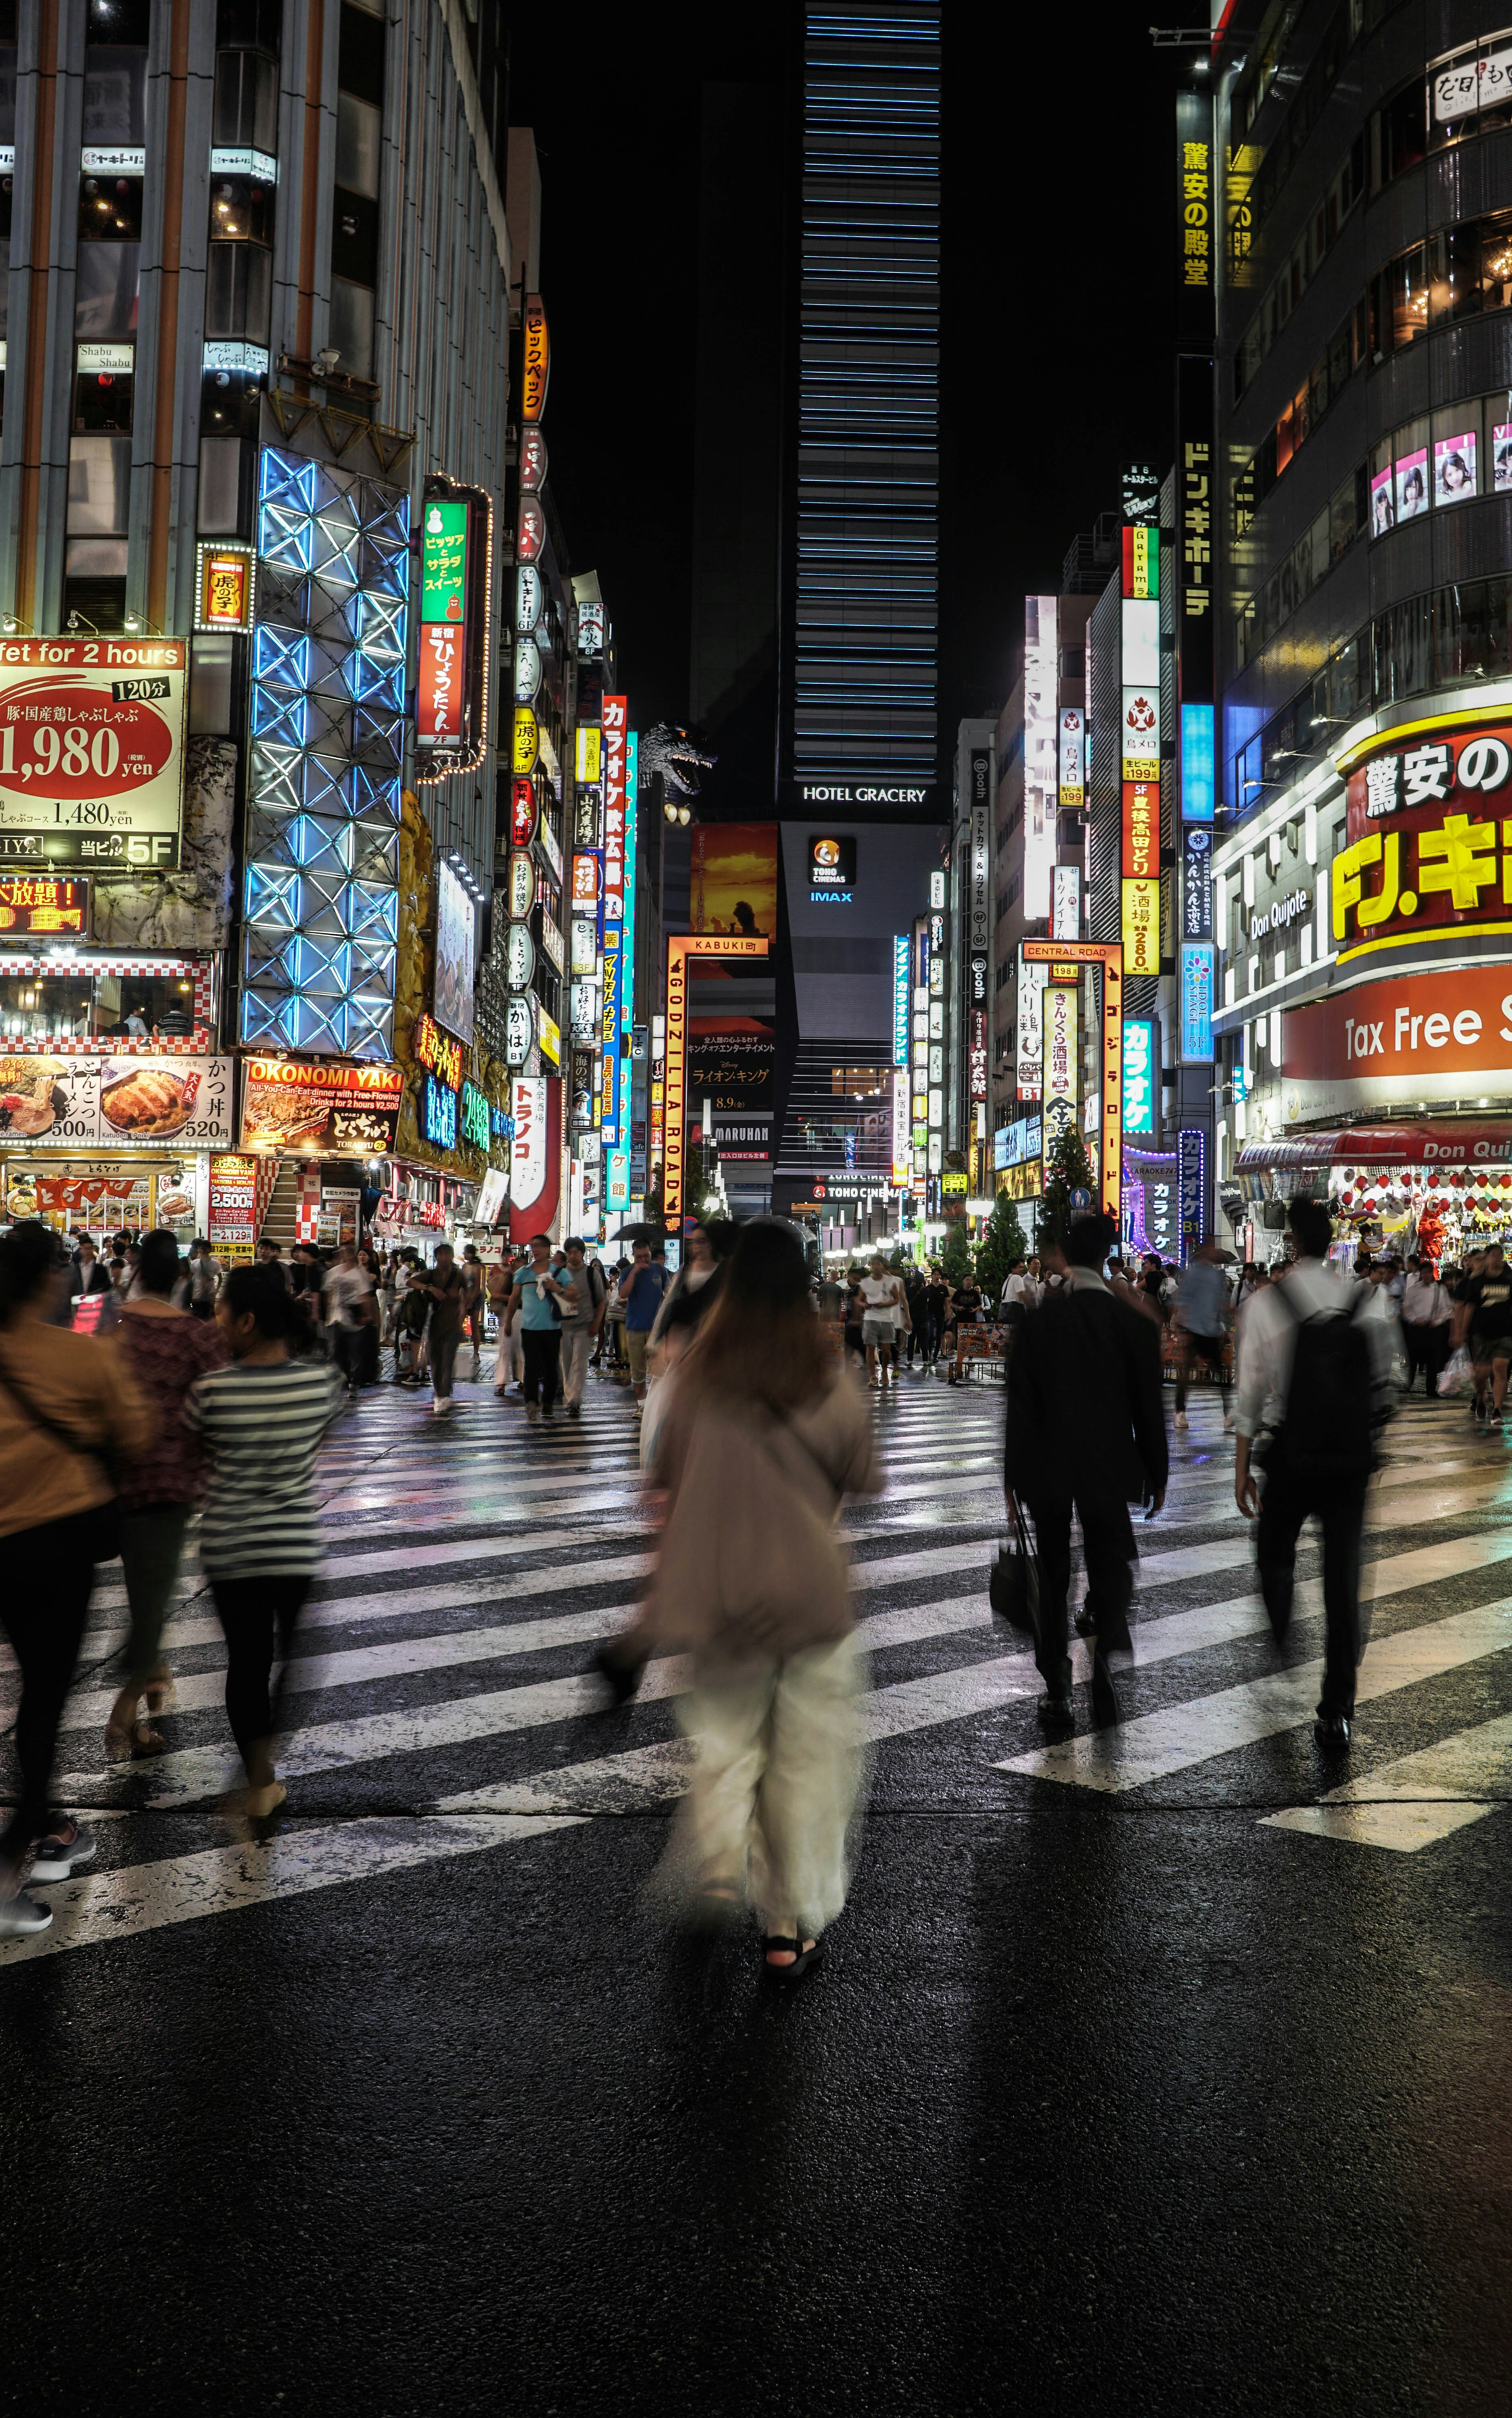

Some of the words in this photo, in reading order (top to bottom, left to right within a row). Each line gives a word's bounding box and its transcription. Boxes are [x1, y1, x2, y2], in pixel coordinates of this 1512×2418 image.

[1183, 142, 1209, 286] 驚安の殿堂
[81, 347, 111, 355] Shabu
[100, 358, 130, 367] Shabu
[427, 555, 461, 571] サラダ
[440, 548, 448, 557] と
[1135, 531, 1147, 583] Garam
[215, 575, 234, 609] 虎の子
[425, 576, 463, 592] スイーツ
[431, 627, 455, 639] 新宿
[519, 620, 534, 629] 6F
[39, 643, 74, 662] for
[83, 644, 98, 663] 2
[108, 644, 178, 665] hours
[117, 679, 166, 700] 120分
[429, 639, 454, 732] ひょうたん
[6, 706, 138, 722] 豚・国産鶏しゃぶしゃぶ
[433, 735, 448, 744] 7F
[516, 725, 534, 758] 虎の子
[0, 726, 119, 782] 1,980
[122, 763, 153, 777] yen
[974, 759, 988, 799] Booth
[1366, 737, 1509, 818] 驚安の
[804, 787, 853, 800] HOTEL
[856, 788, 926, 802] GRACERY
[1064, 793, 1081, 801] 199
[1134, 785, 1147, 794] 5F
[53, 803, 109, 826] 1,480
[110, 815, 132, 826] yen
[579, 795, 594, 838] 山内農場
[976, 812, 984, 858] ネットカフェ
[1131, 797, 1151, 875] 豊後高田どり
[127, 836, 172, 863] 5F
[813, 868, 837, 876] TOHO
[1333, 813, 1512, 941] ドン・キ
[811, 892, 852, 902] IMAX
[1131, 894, 1151, 923] 酒場
[1251, 914, 1269, 941] Don
[1271, 888, 1307, 928] Quijote
[605, 933, 617, 946] 薬
[1028, 947, 1075, 956] CENTRAL
[1135, 933, 1146, 966] 280
[516, 938, 525, 980] とらそば
[972, 958, 987, 999] Booth
[1188, 985, 1199, 1025] STAGE
[1198, 986, 1208, 1018] IDOL
[896, 980, 908, 1060] カラオケランド
[1345, 1018, 1385, 1060] Tax
[1394, 1006, 1482, 1051] Free
[668, 978, 683, 1111] GODZILLA
[1053, 993, 1067, 1074] きんくら酒場
[1188, 1036, 1206, 1049] 5F
[688, 1044, 775, 1053] キング・オブ・エンターテイメント
[251, 1062, 349, 1086] OKONOMI
[357, 1070, 402, 1091] YAKI
[575, 1054, 588, 1089] 海の家
[603, 1053, 614, 1079] Shop
[693, 1068, 769, 1084] ライオン・キング
[970, 1049, 987, 1095] 甘太郎
[1124, 1024, 1149, 1129] カラオケ
[64, 1062, 78, 1118] ラーメン
[81, 1061, 97, 1118] とんこつ
[183, 1074, 198, 1101] 大人気
[206, 1060, 226, 1117] かつ丼
[250, 1084, 311, 1095] All-You-Can-Eat
[311, 1088, 336, 1097] dinner
[337, 1090, 352, 1098] with
[354, 1091, 400, 1102] Free-Flowing
[602, 1080, 613, 1104] Free
[1022, 1089, 1041, 1100] B1
[1107, 1005, 1120, 1181] ゴジラロード
[310, 1097, 334, 1106] Drinks
[335, 1099, 346, 1107] for
[353, 1100, 375, 1109] hours
[376, 1102, 399, 1111] ¥2,500
[535, 1080, 545, 1123] 大衆酒場
[602, 1105, 612, 1116] Tax
[716, 1097, 745, 1108] 8.9(金)
[1300, 1094, 1312, 1110] Don
[1313, 1093, 1336, 1110] Quijote
[52, 1121, 94, 1137] 500円
[185, 1121, 228, 1137] 520円
[515, 1085, 532, 1159] トラノコ
[652, 1109, 662, 1124] 麻雀
[896, 1089, 906, 1162] 新宿東宝ビル店
[716, 1128, 769, 1140] MARUHAN
[666, 1128, 680, 1190] ROAD
[1423, 1143, 1465, 1158] Don
[89, 1165, 121, 1173] とらそば
[1182, 1135, 1200, 1217] カラオケ
[828, 1188, 857, 1197] TOHO
[1153, 1183, 1170, 1249] カラオケ
[1182, 1219, 1200, 1234] B1
